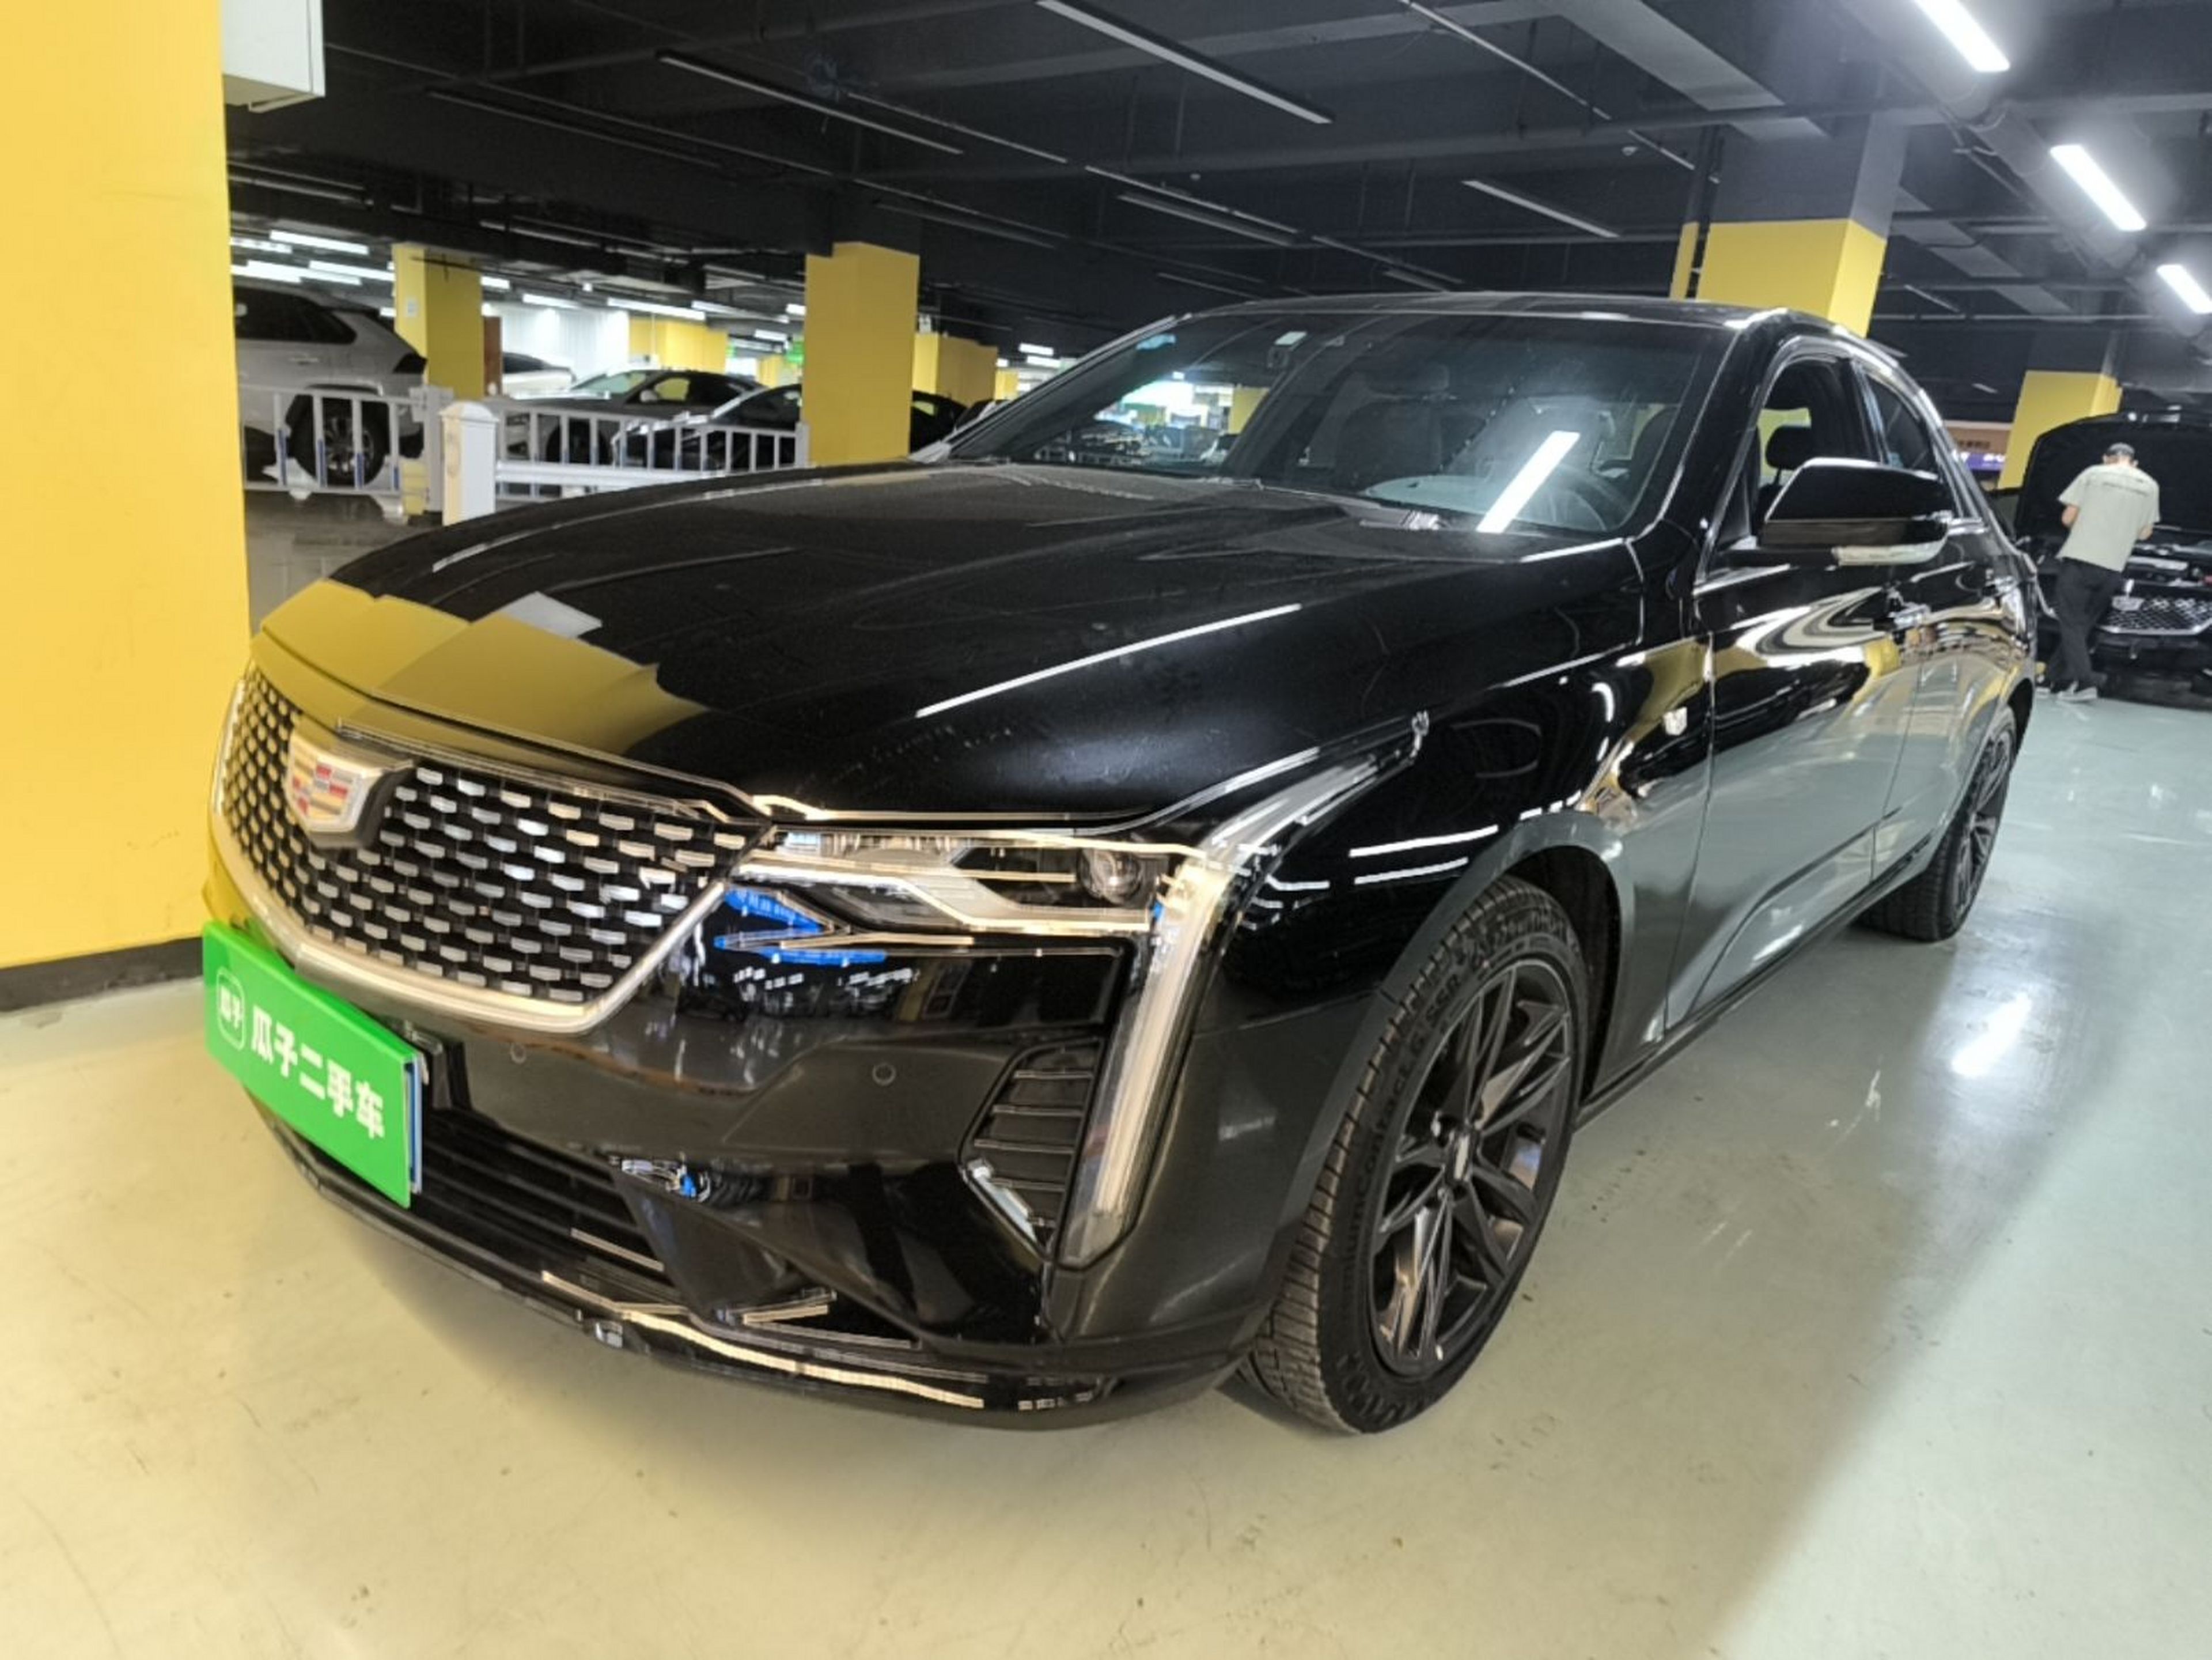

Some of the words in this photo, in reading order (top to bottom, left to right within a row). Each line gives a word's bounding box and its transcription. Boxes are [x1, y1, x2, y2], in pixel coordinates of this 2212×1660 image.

[251, 1003, 385, 1140] 瓜子二手车
